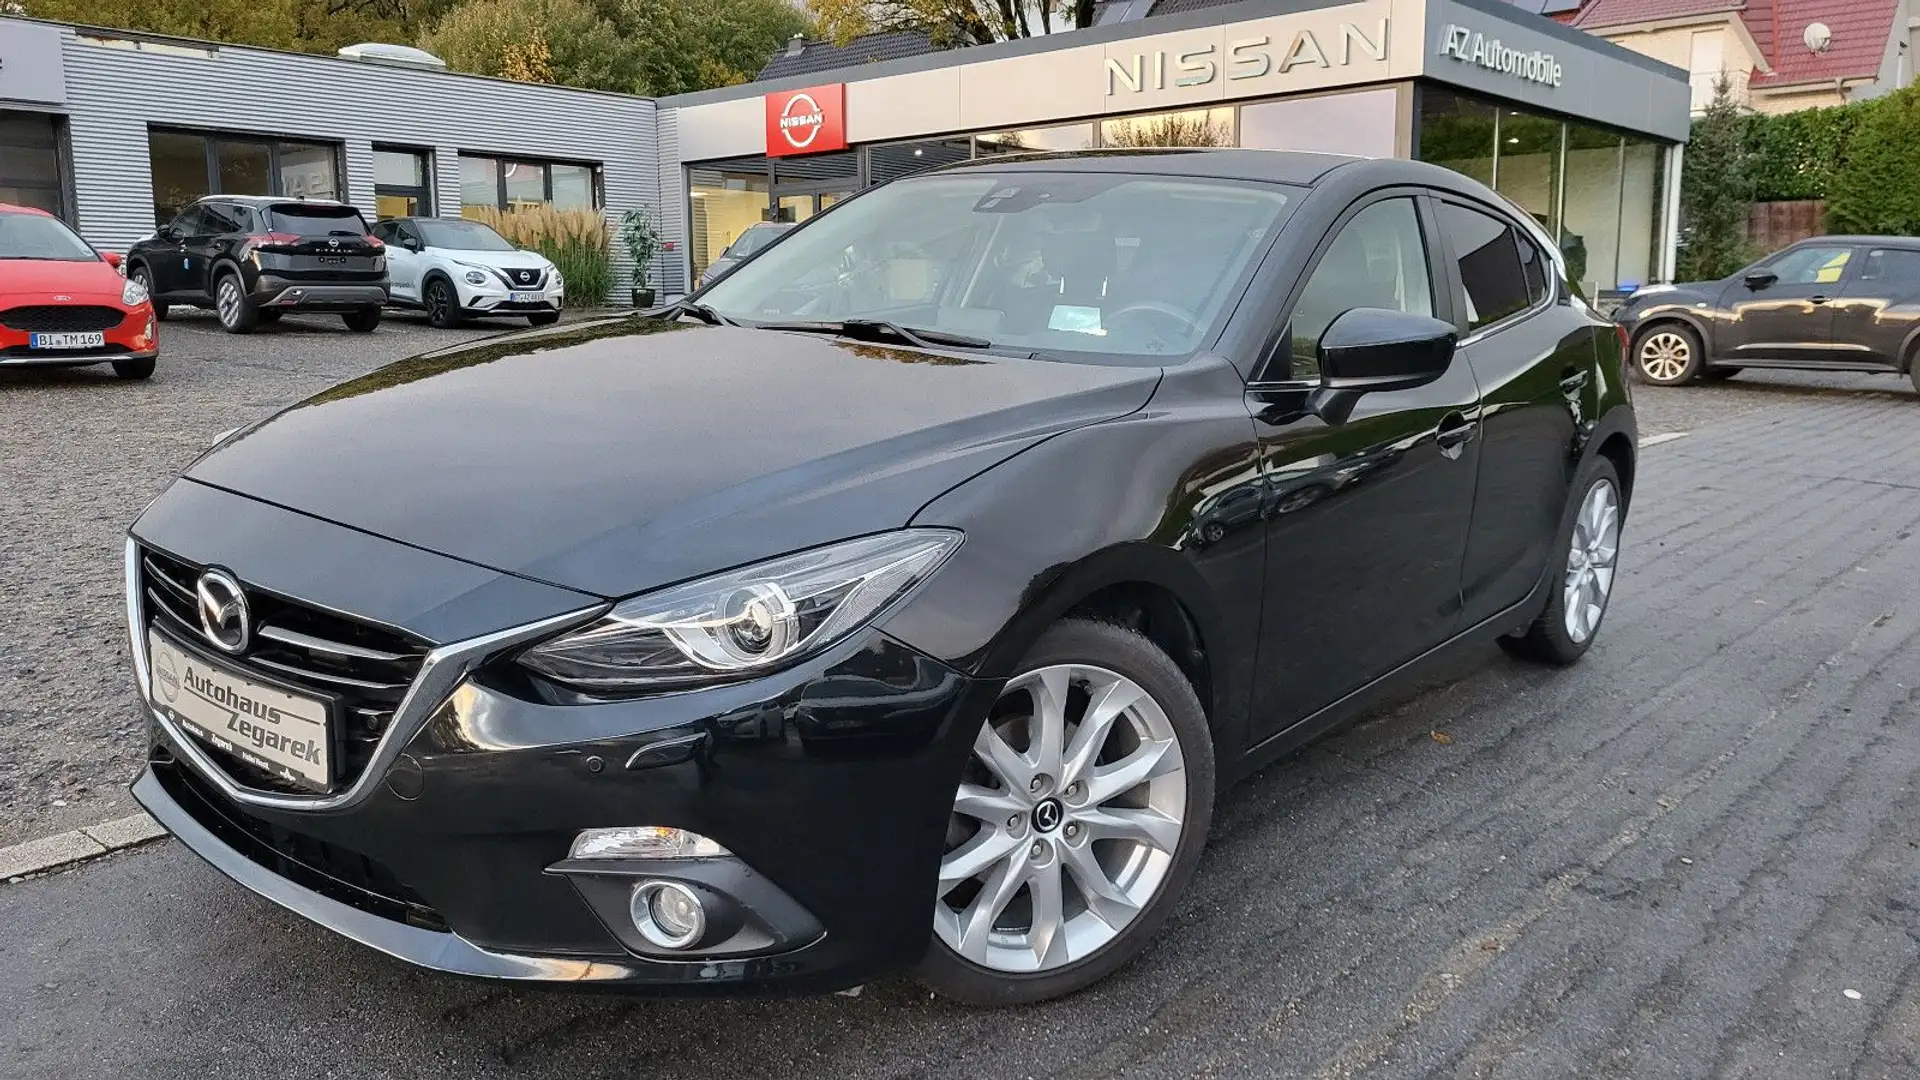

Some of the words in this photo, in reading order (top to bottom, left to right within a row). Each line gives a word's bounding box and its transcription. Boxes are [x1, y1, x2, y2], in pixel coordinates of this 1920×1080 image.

[1104, 17, 1388, 96] NISSAN
[1440, 23, 1471, 61] AZ
[1472, 32, 1562, 87] Automobile
[780, 113, 822, 128] NISSAN
[39, 334, 54, 346] BI
[62, 334, 78, 345] TM
[80, 333, 102, 345] 169
[183, 666, 282, 725] Autohaus
[227, 712, 321, 766] Zegarek
